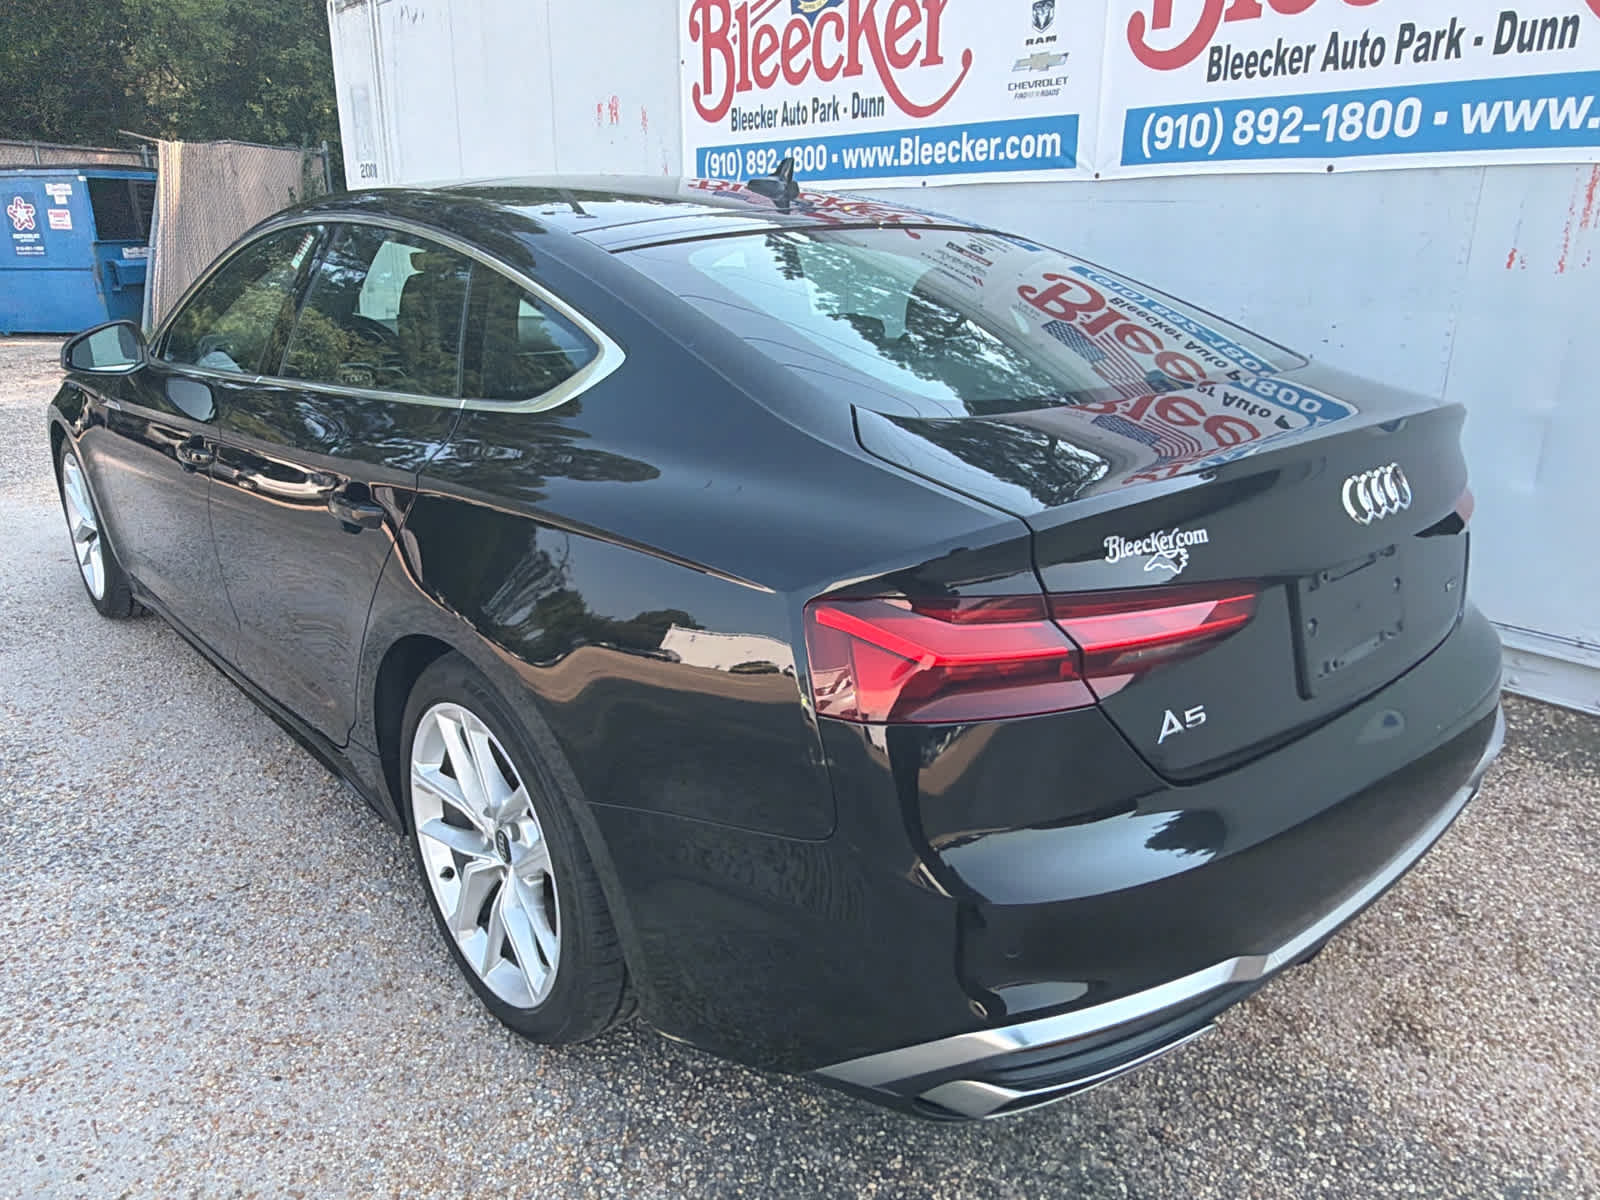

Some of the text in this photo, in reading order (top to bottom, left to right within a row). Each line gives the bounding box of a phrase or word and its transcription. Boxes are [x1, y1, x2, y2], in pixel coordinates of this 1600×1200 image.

[1025, 35, 1057, 46] RAM
[1207, 38, 1316, 82] Bleecker
[1320, 29, 1386, 72] Auto
[1394, 17, 1466, 65] Park
[1493, 10, 1580, 55] Dunn
[1008, 76, 1068, 92] CHEVROLET
[731, 92, 885, 132] Bleecker Auto Park Dunn
[1141, 108, 1223, 158] (910)
[1232, 97, 1422, 146] 892-1800
[705, 149, 742, 181] (910)
[843, 132, 1061, 169] www.Bleecker.com
[1157, 704, 1207, 745] A5
